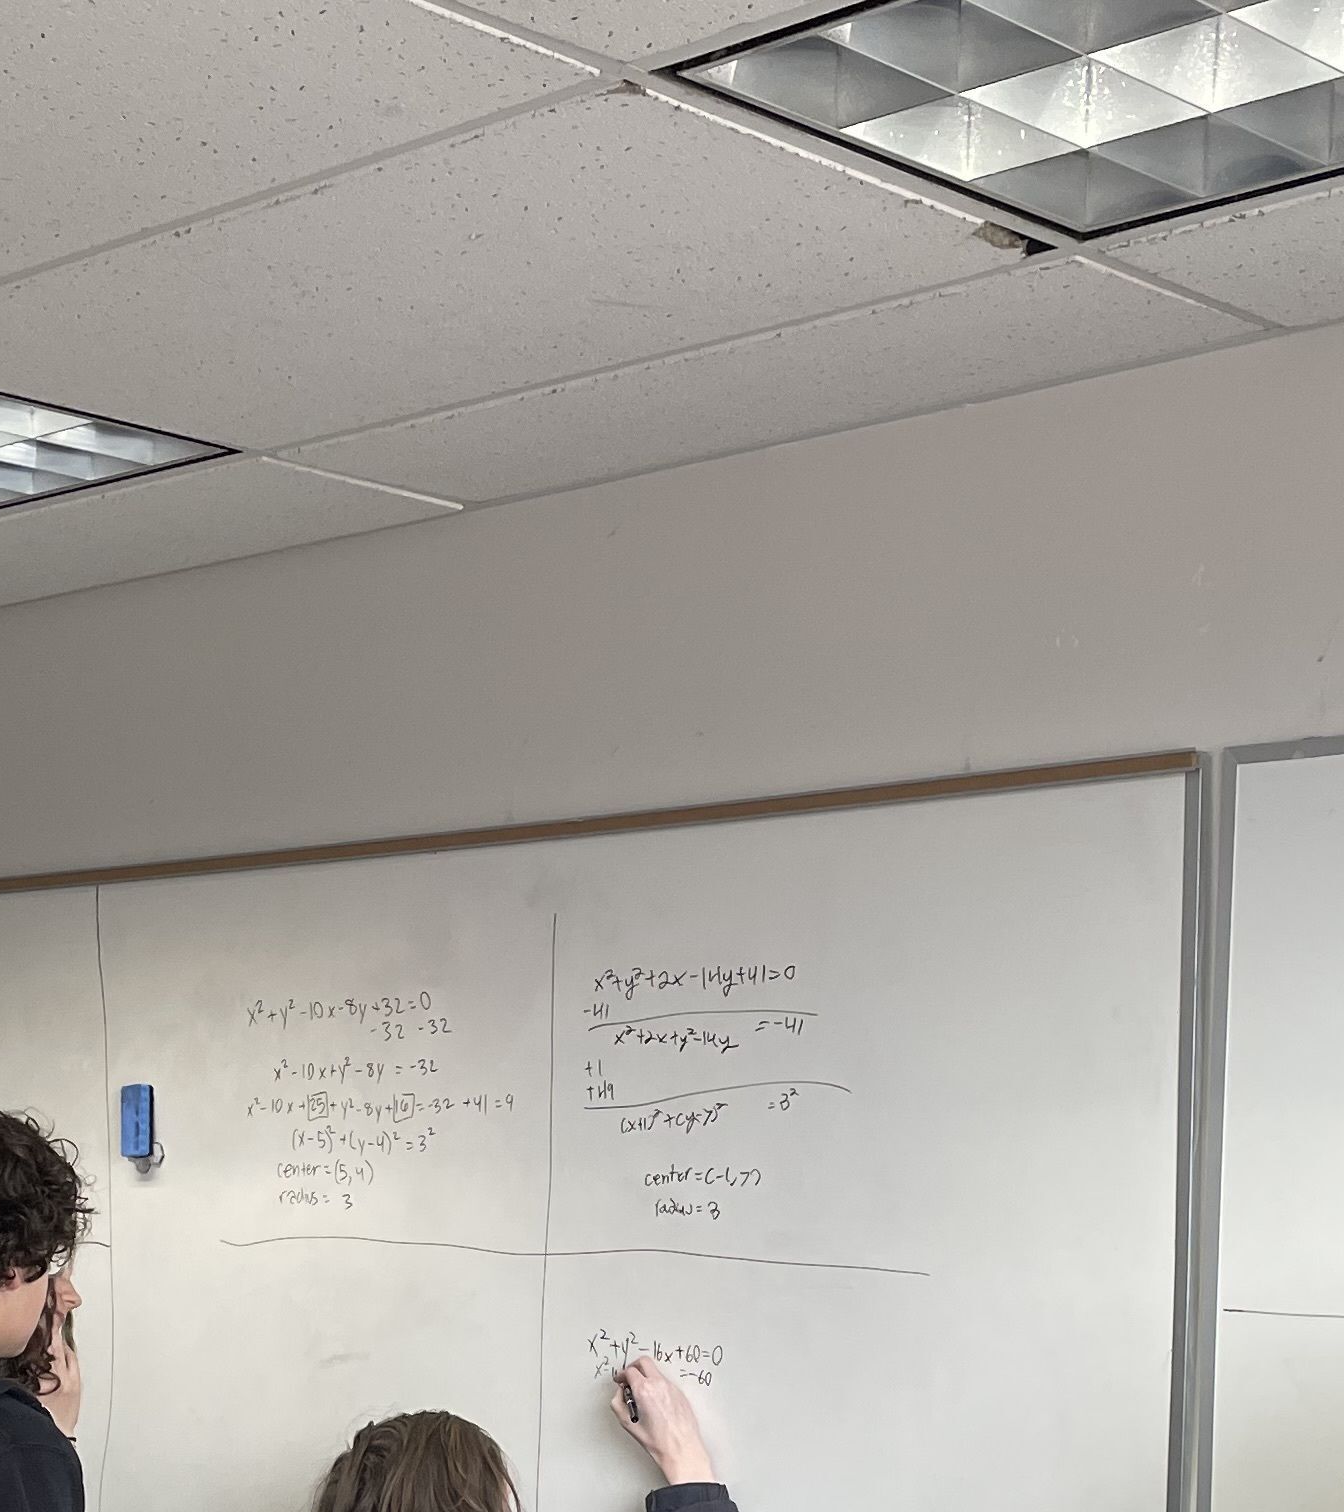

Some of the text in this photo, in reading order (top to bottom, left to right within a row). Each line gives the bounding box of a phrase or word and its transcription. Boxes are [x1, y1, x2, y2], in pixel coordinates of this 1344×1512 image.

[583, 1003, 609, 1019] -41
[370, 1017, 453, 1041] -32 -32
